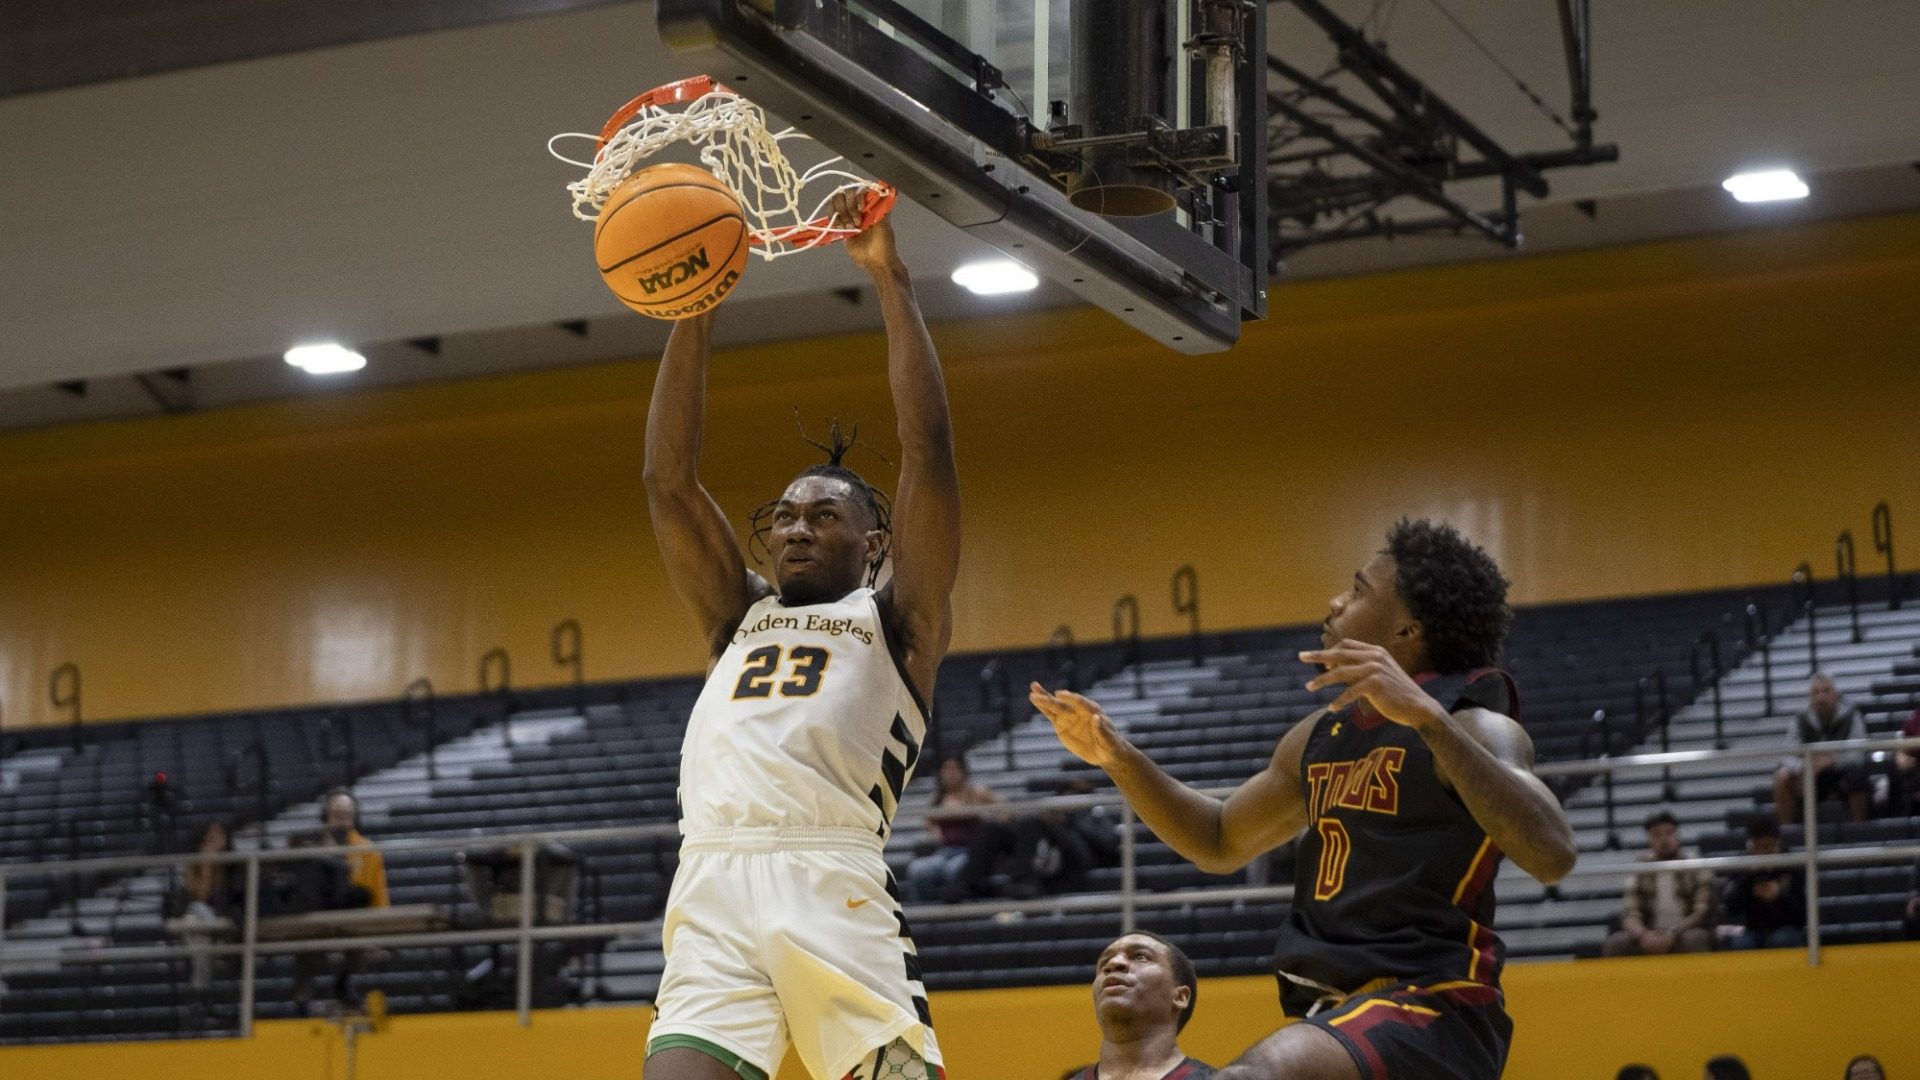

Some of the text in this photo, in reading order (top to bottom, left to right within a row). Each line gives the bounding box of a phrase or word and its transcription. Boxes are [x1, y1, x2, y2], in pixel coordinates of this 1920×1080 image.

[637, 246, 711, 295] NCAA
[643, 269, 740, 317] Wilson
[731, 614, 874, 646] Gden Eagles
[730, 642, 832, 701] 23
